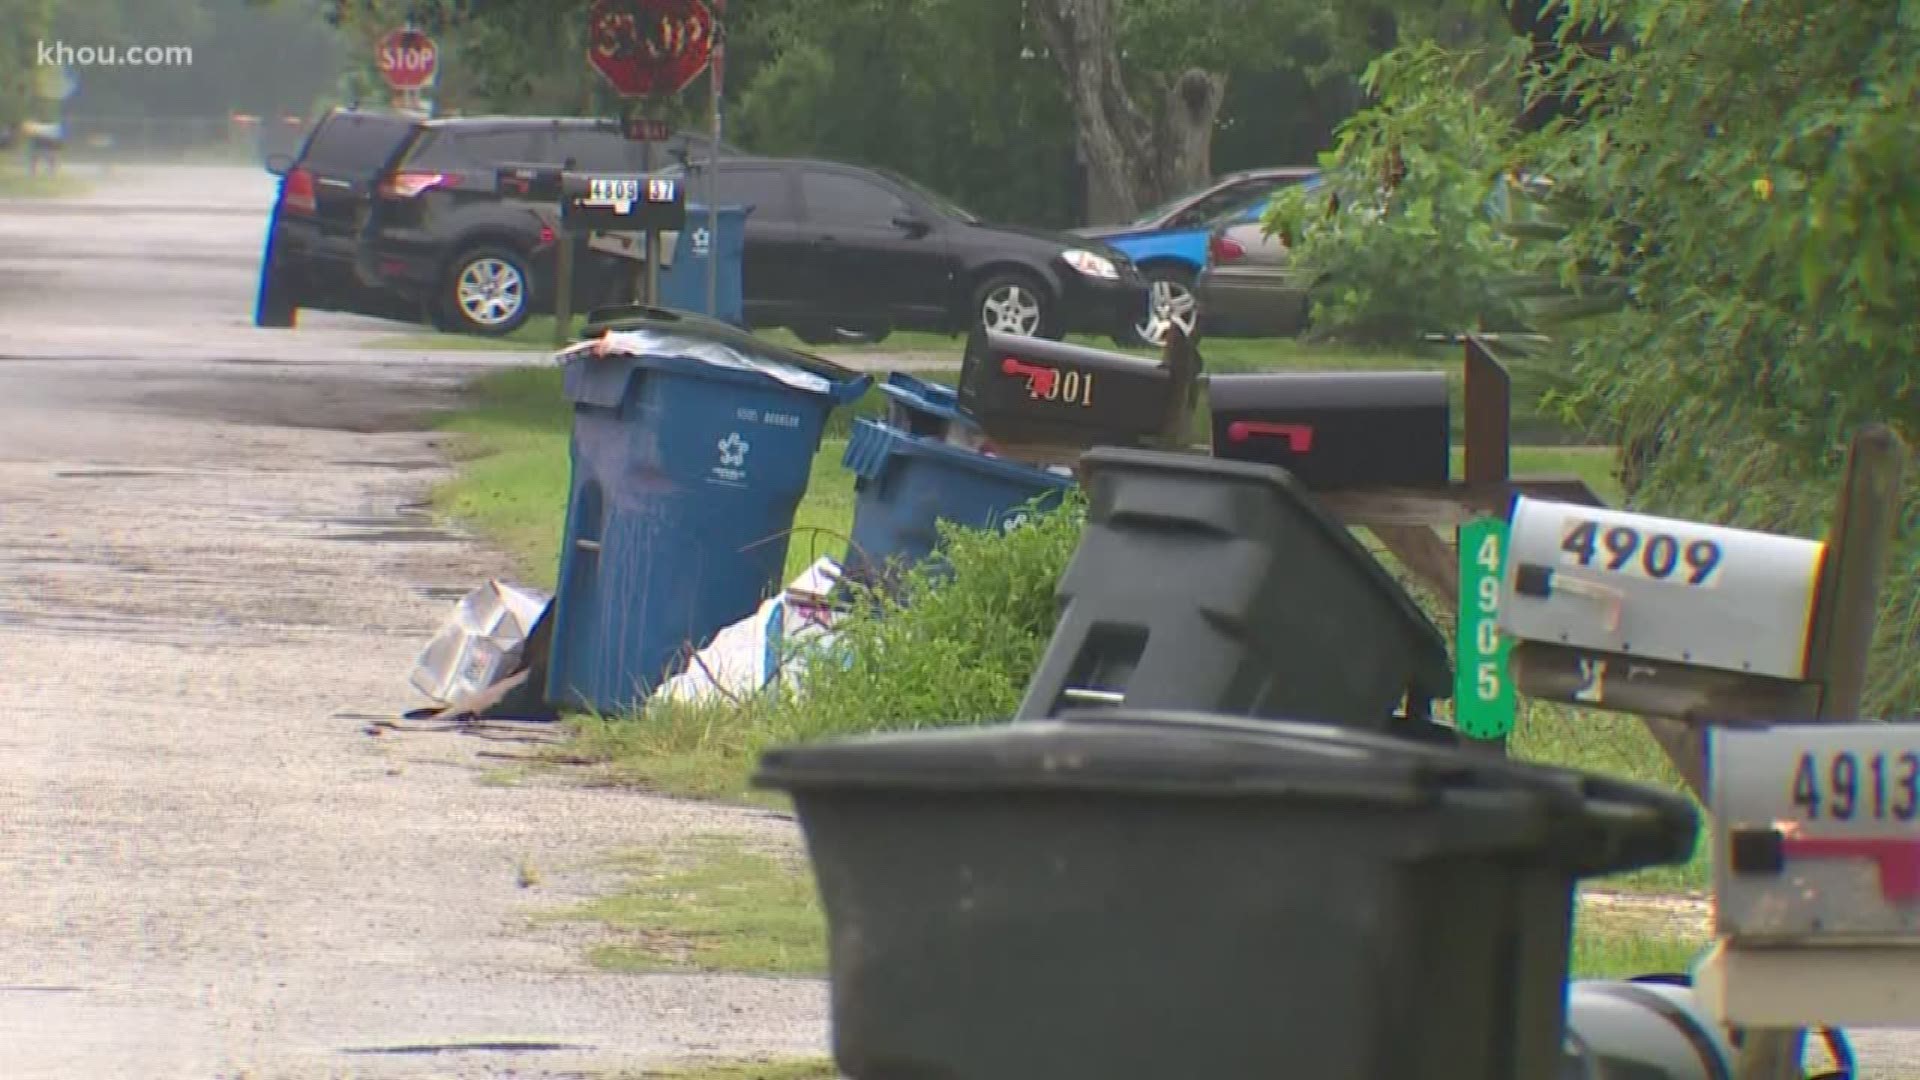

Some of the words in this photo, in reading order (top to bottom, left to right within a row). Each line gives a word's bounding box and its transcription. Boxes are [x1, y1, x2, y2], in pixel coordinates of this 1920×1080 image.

[381, 47, 433, 71] STOP
[598, 13, 702, 57] SOP
[592, 180, 637, 200] 4809
[1562, 520, 1722, 587] 4909
[1476, 533, 1500, 701] 4905
[1793, 751, 1920, 821] 4913
